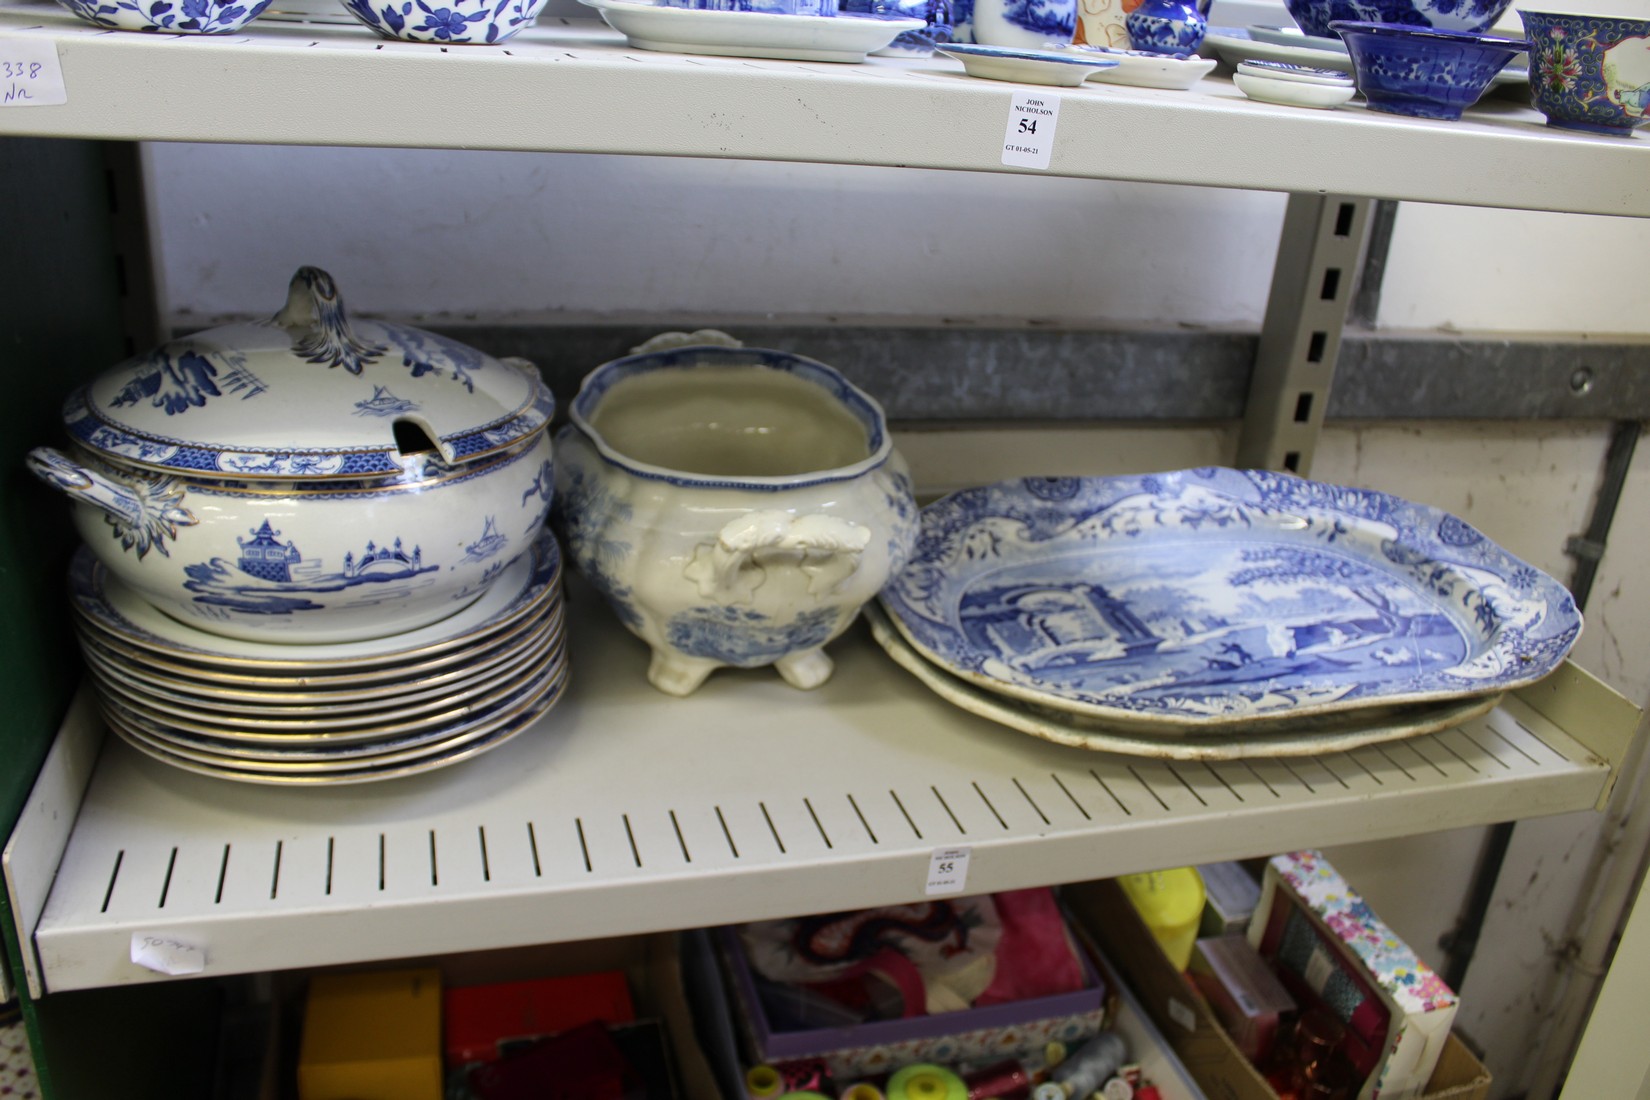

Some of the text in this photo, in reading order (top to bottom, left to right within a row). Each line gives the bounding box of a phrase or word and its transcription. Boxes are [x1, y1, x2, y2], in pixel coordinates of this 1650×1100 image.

[2, 62, 42, 79] 338
[1026, 98, 1044, 106] JOHN
[1015, 105, 1053, 115] NICHOLSON
[1018, 118, 1037, 135] 54
[1016, 146, 1038, 154] 01-05-21
[939, 862, 952, 873] 55
